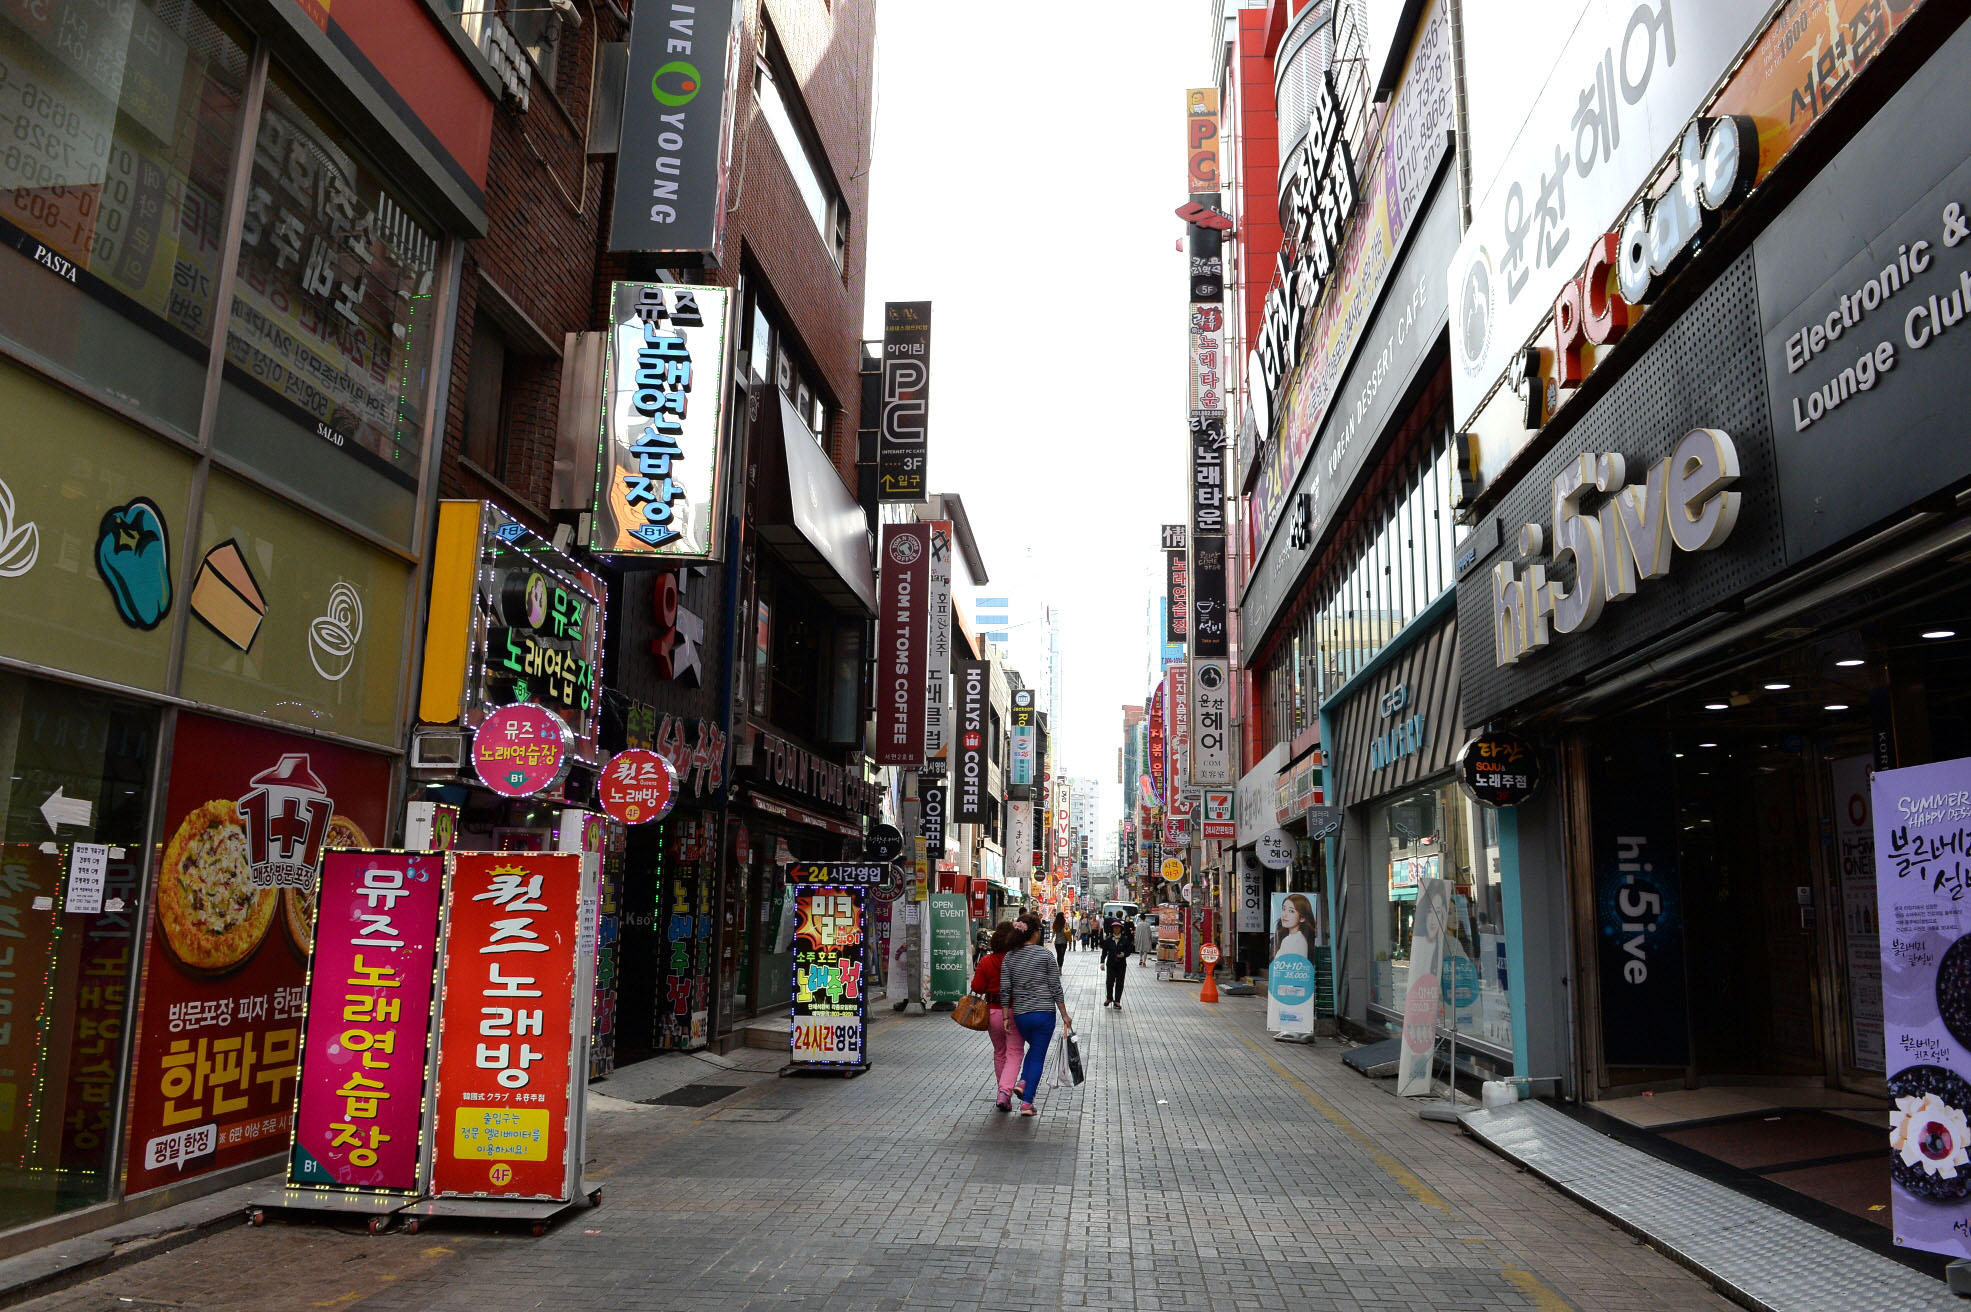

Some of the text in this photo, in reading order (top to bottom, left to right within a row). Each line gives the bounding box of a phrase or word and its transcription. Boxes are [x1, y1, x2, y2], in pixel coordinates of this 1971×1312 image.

[1188, 118, 1217, 183] PC
[1500, 0, 1677, 306] 윤찬헤어
[649, 112, 685, 224] YOUNG
[33, 245, 77, 283] PASTA
[1202, 285, 1213, 294] 5F
[1785, 202, 1970, 375] Electronic &
[1555, 231, 1629, 391] PC
[1198, 335, 1220, 410] 노래타운
[1328, 273, 1428, 479] KOREAN DESSERT CAFE
[1792, 340, 1896, 432] Lounge
[883, 359, 927, 443] PC
[317, 421, 344, 447] SALAD
[624, 323, 693, 523] 노래연습장
[904, 458, 922, 470] 3F
[898, 475, 921, 486] 입구
[1197, 446, 1223, 530] 노래타운
[1266, 452, 1282, 512] 24
[645, 526, 663, 537] B1
[1163, 526, 1186, 547] 情
[1492, 427, 1742, 668] hi-5ive
[551, 587, 583, 642] 뮤즈
[1198, 621, 1222, 635] 설빙
[503, 627, 595, 711] 노래연습장
[893, 571, 911, 744] TOM N TOMS COFFEE
[504, 720, 535, 738] 뮤즈
[963, 668, 982, 813] HOLLYS COFFEE
[1200, 711, 1223, 751] 헤어
[479, 744, 558, 767] 노래연습장
[1371, 714, 1424, 772] GALLERY
[1476, 741, 1525, 763] 타잔
[510, 773, 524, 784] B1
[612, 762, 659, 785] 퀸즈
[763, 734, 798, 790] TOM
[799, 746, 809, 795] N
[810, 754, 845, 807] TOMS
[1200, 770, 1225, 779] 美容室
[1475, 762, 1501, 772] SOJU
[1475, 773, 1528, 789] 노래주점
[609, 787, 660, 808] 노래방
[1897, 790, 1971, 822] SUMMER
[626, 808, 639, 818] 4F
[926, 787, 942, 851] COFFEE
[1908, 811, 1946, 829] HAPPY
[238, 788, 333, 867] 1+1
[1060, 809, 1069, 848] DVD
[1204, 825, 1234, 835] 24시간편의점
[1164, 861, 1178, 869] 사격
[1270, 849, 1293, 859] 헤어
[808, 867, 881, 882] 24 시간영업
[932, 901, 954, 909] OPEN
[1245, 884, 1260, 910] 헤어
[940, 909, 965, 918] EVENT
[796, 952, 837, 963] 소주 호프
[1891, 938, 1926, 958] 블루베리
[471, 874, 550, 1089] 퀸즈 노래방
[796, 957, 861, 1004] 노래주점
[169, 998, 234, 1033] 방문포장
[238, 994, 268, 1022] 피자
[329, 868, 410, 1168] 뮤즈 노래연습장
[794, 1024, 859, 1052] 24시간영업
[1899, 1034, 1940, 1052] 블루베리
[1914, 1048, 1950, 1063] 치즈 설빙
[161, 1028, 299, 1127] 한판무
[487, 1093, 510, 1102] クラブ
[229, 1115, 287, 1143] 6판 이상 주문 시
[484, 1112, 521, 1125] 출입구는
[155, 1129, 209, 1164] 평일 한정
[461, 1127, 541, 1142] 정문 엘리베이터를
[476, 1143, 529, 1156] 이용하세요!
[303, 1159, 319, 1174] B1
[491, 1168, 511, 1182] 4F
